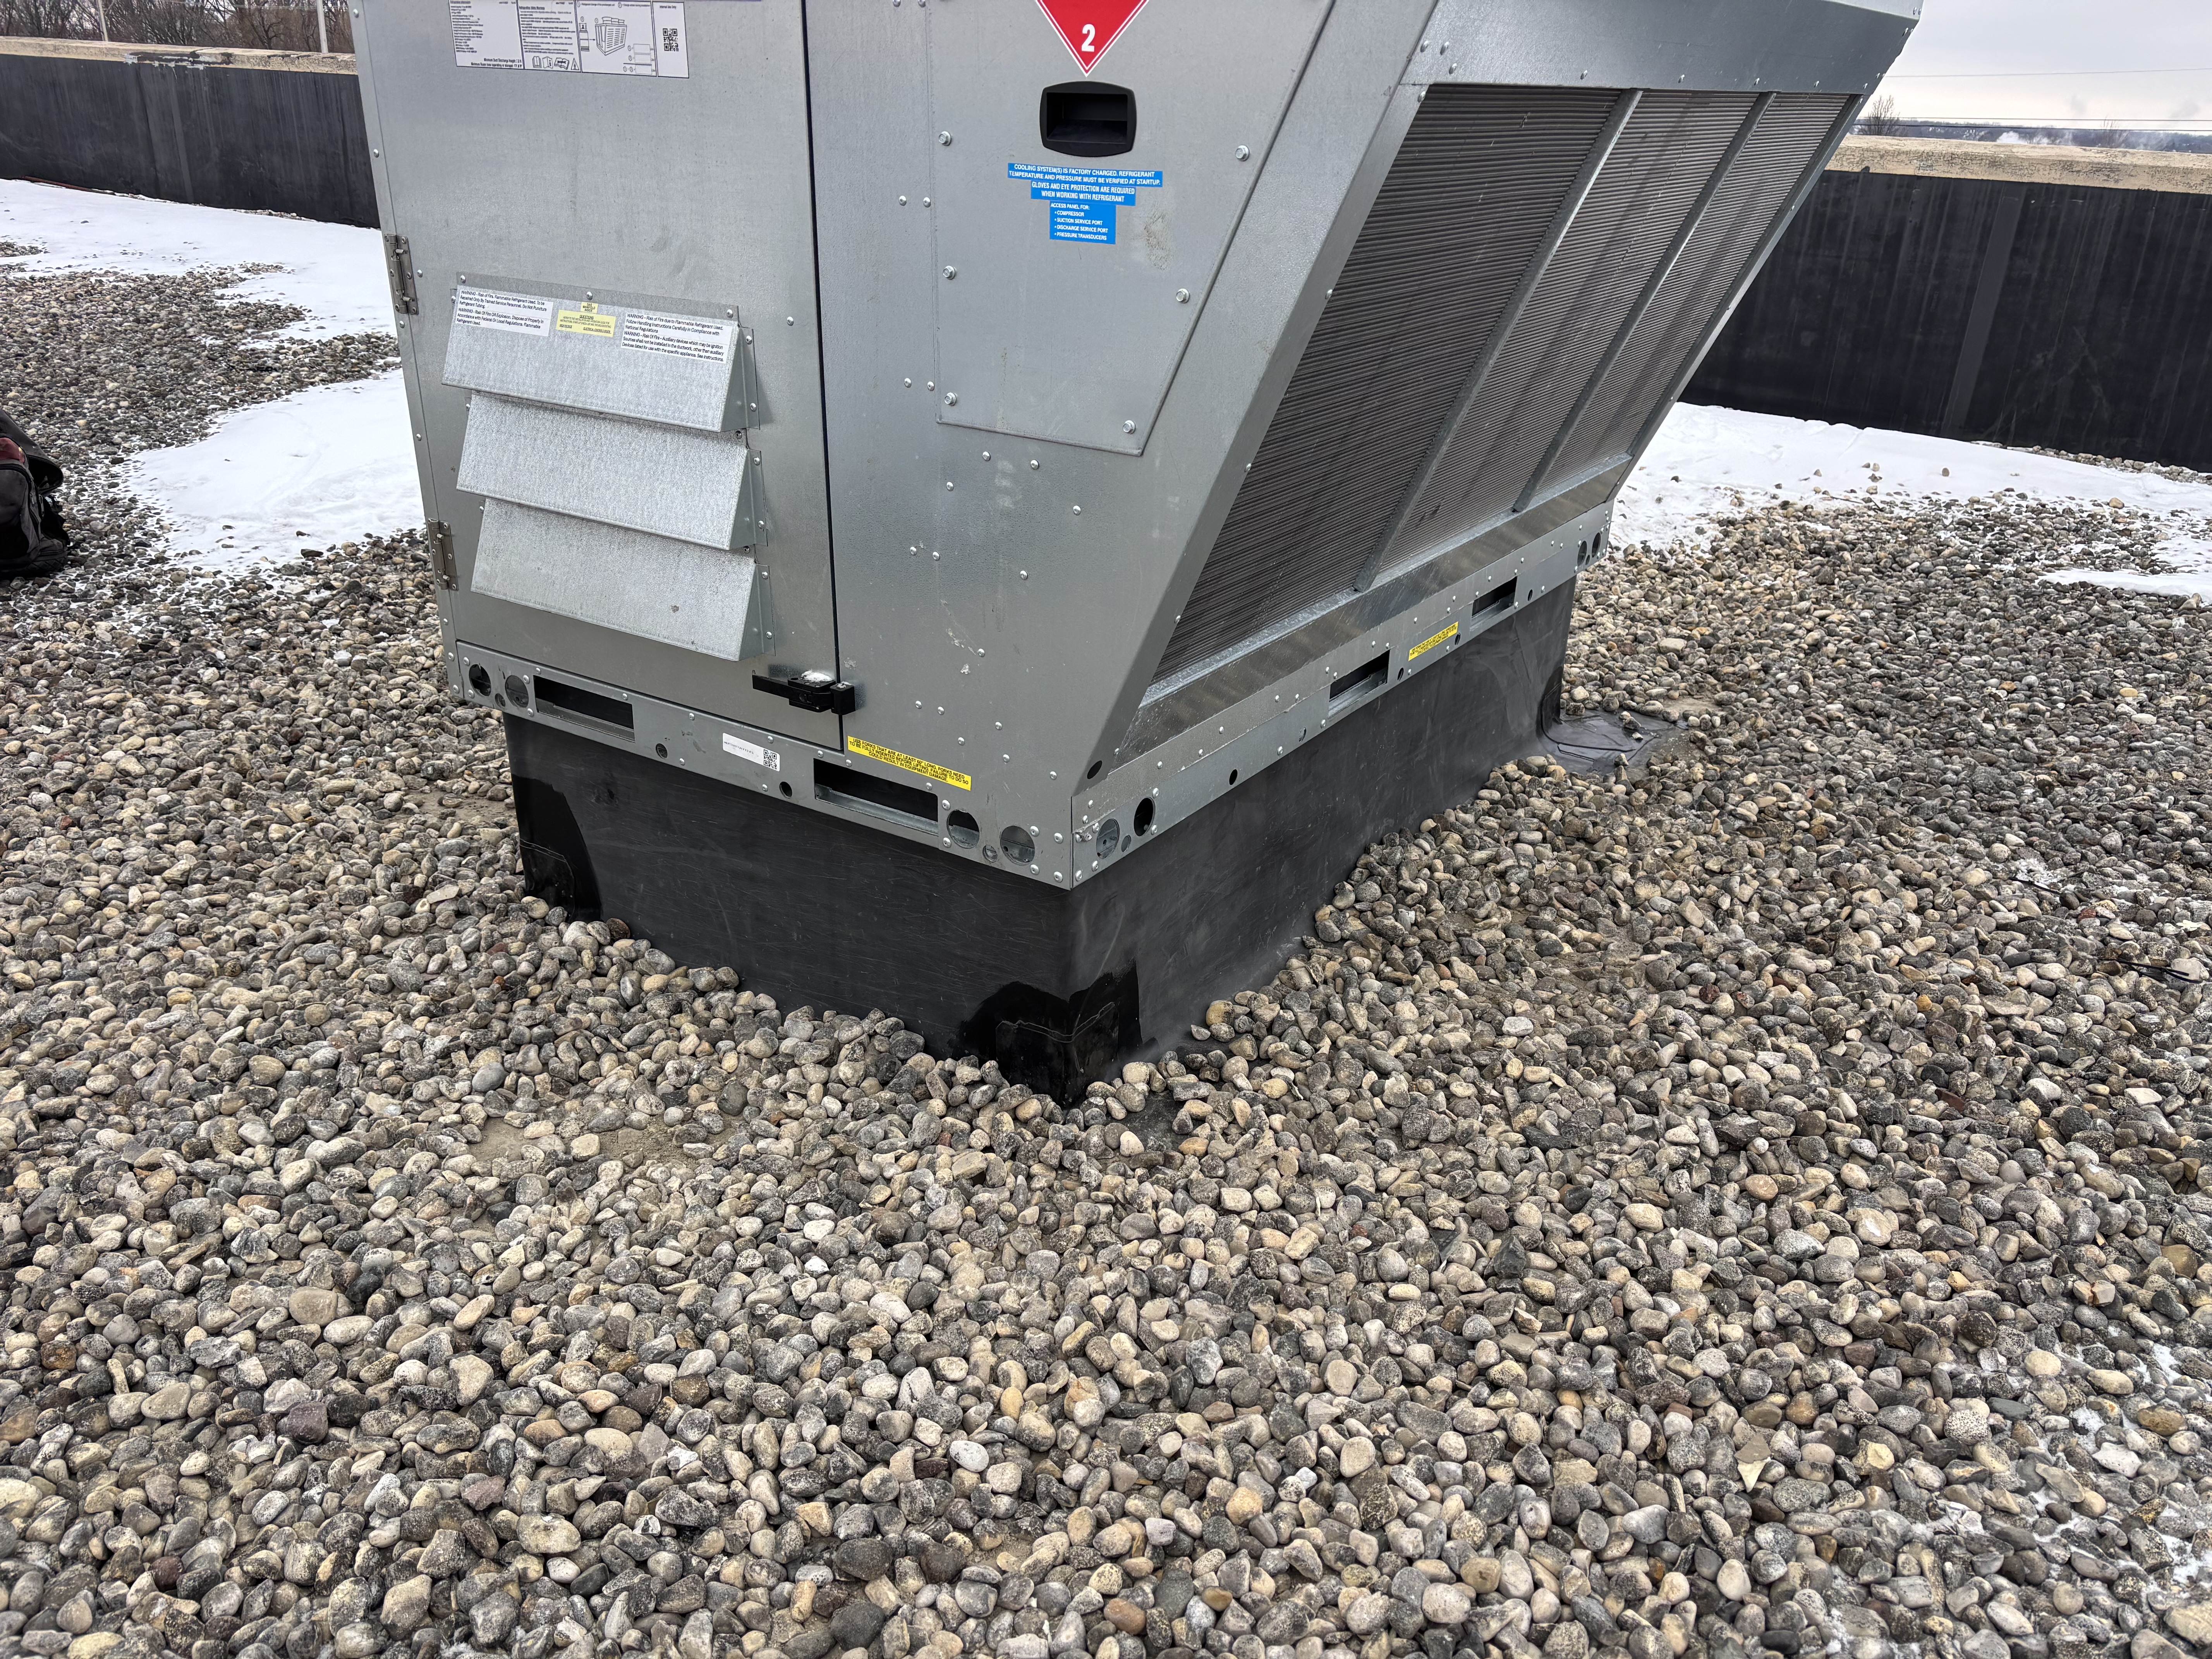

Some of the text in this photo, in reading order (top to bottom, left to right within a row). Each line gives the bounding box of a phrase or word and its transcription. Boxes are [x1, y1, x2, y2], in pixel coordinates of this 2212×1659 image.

[1082, 24, 1096, 52] 2
[1009, 170, 1044, 179] TEMPERATURE
[1071, 184, 1099, 192] PROTECTION
[1092, 194, 1124, 202] REFRIGERANT
[896, 757, 912, 766] BEFORE
[930, 769, 947, 777] FAILURE
[929, 772, 948, 781] DAMAGE.
